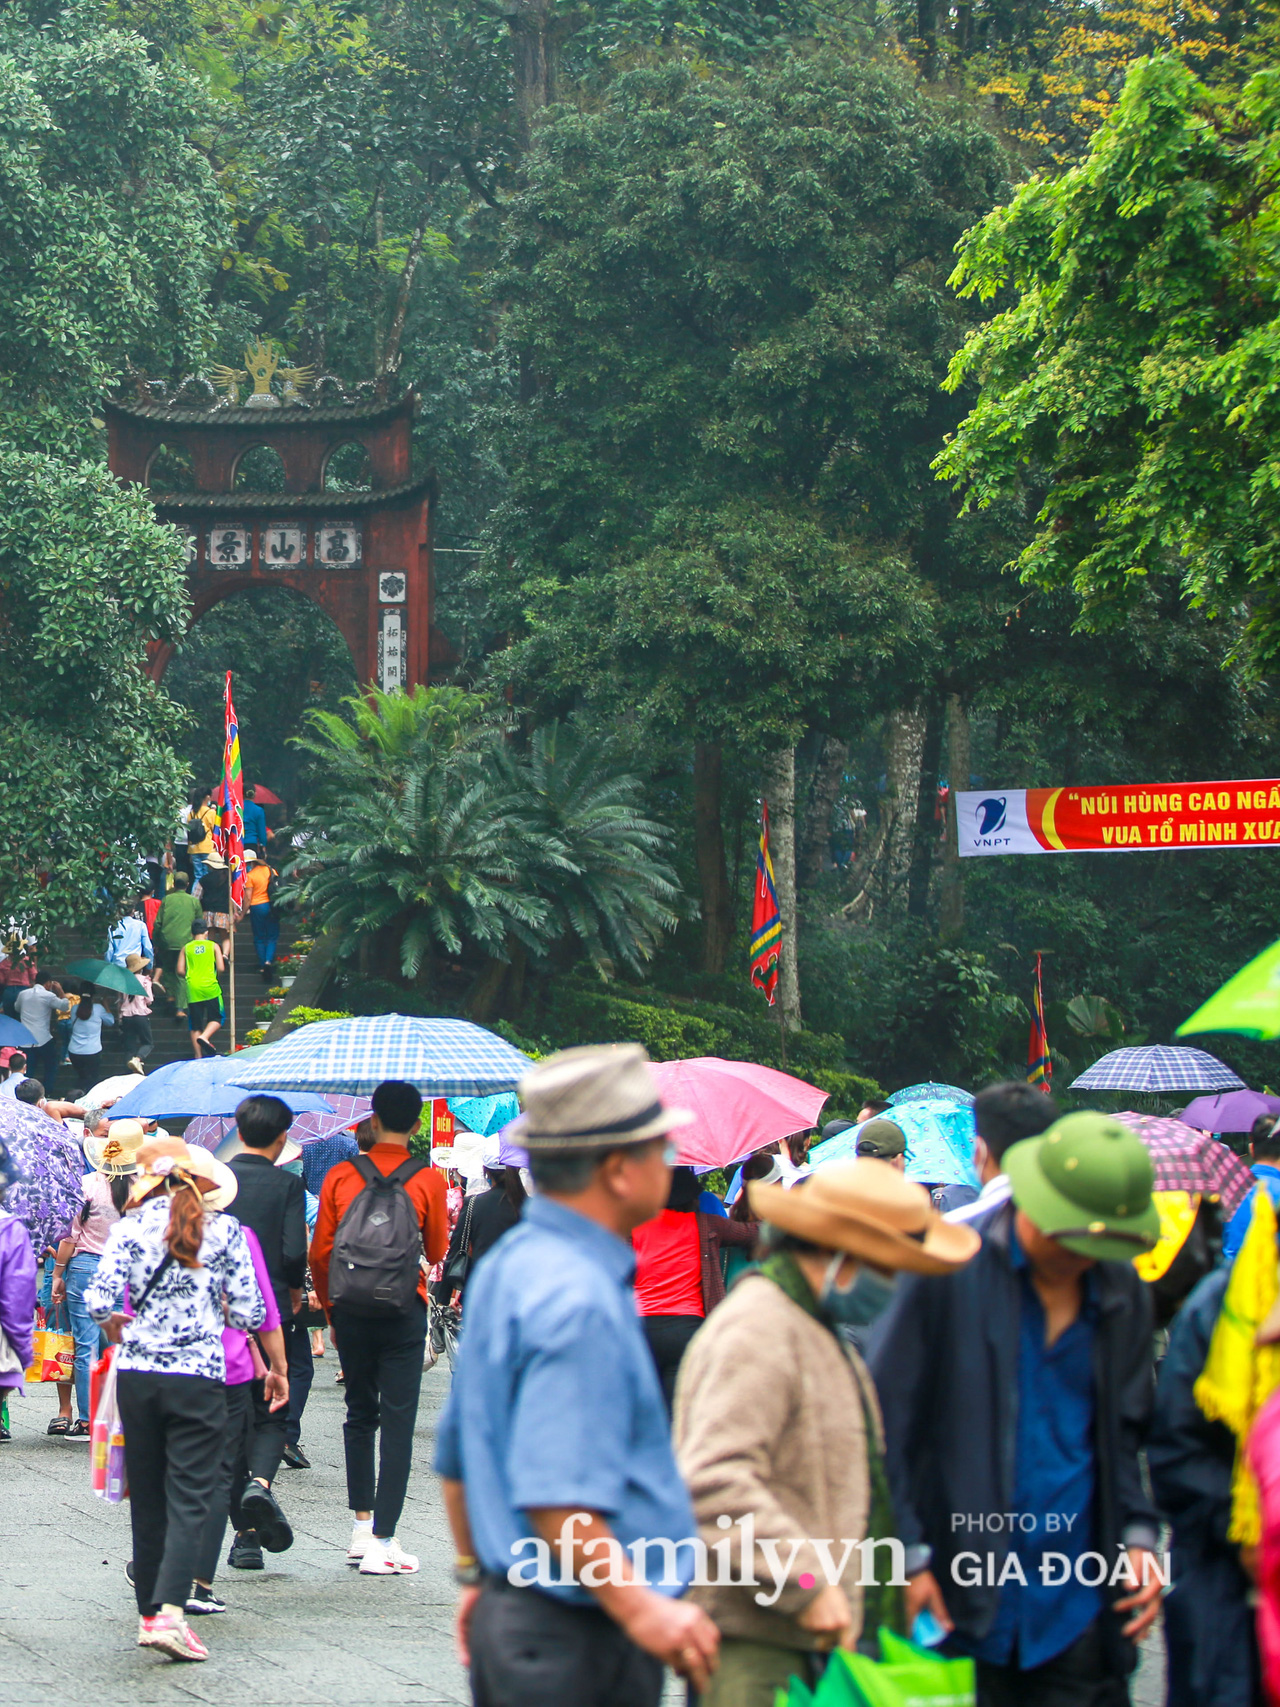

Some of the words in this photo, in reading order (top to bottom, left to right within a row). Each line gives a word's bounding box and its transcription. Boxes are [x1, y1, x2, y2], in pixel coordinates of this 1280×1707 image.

[1124, 791, 1182, 813] HÙNG
[1188, 792, 1230, 811] CAO
[1102, 826, 1142, 844] VUA
[1147, 817, 1173, 843] TỔ
[1179, 819, 1237, 842] MÌNH
[974, 838, 1011, 847] VNPT
[194, 945, 205, 954] 23
